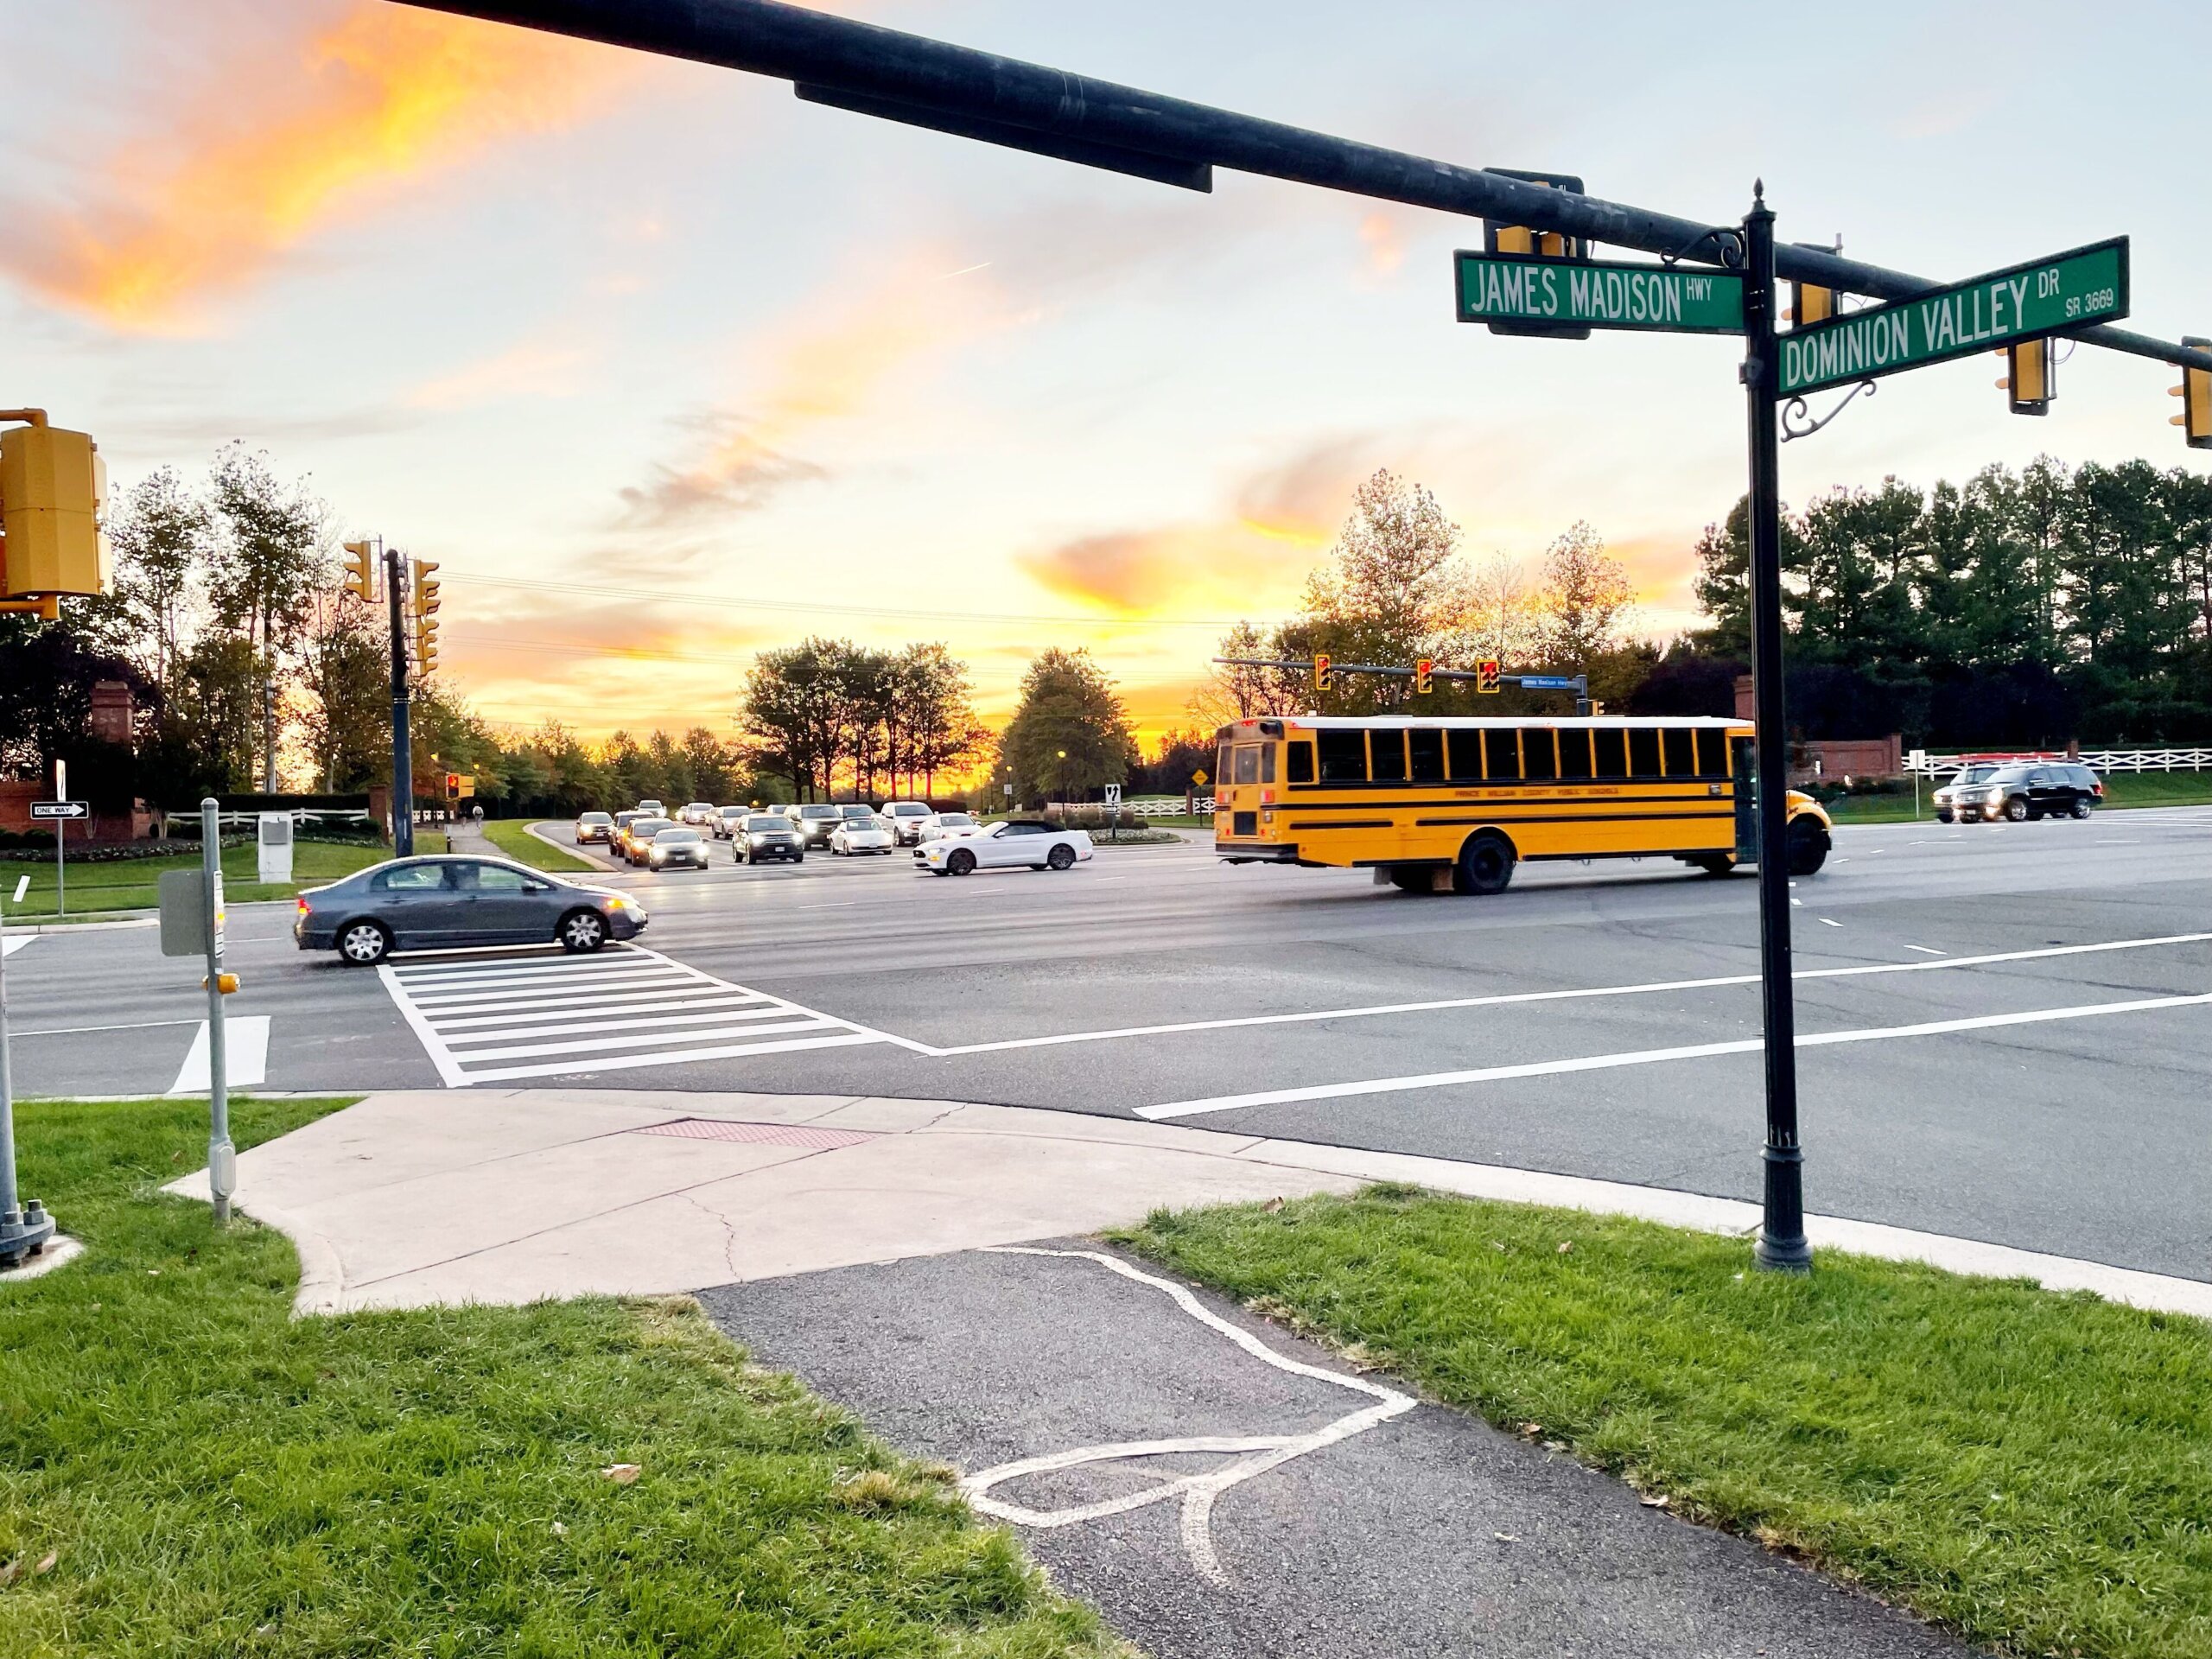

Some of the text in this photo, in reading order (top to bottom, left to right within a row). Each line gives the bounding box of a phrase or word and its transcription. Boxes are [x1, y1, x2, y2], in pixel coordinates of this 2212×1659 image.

[1471, 264, 1713, 322] JAMES MADISON HWY
[2065, 287, 2114, 318] SR 3669
[1786, 268, 2060, 388] DOMINION VALLEY DR
